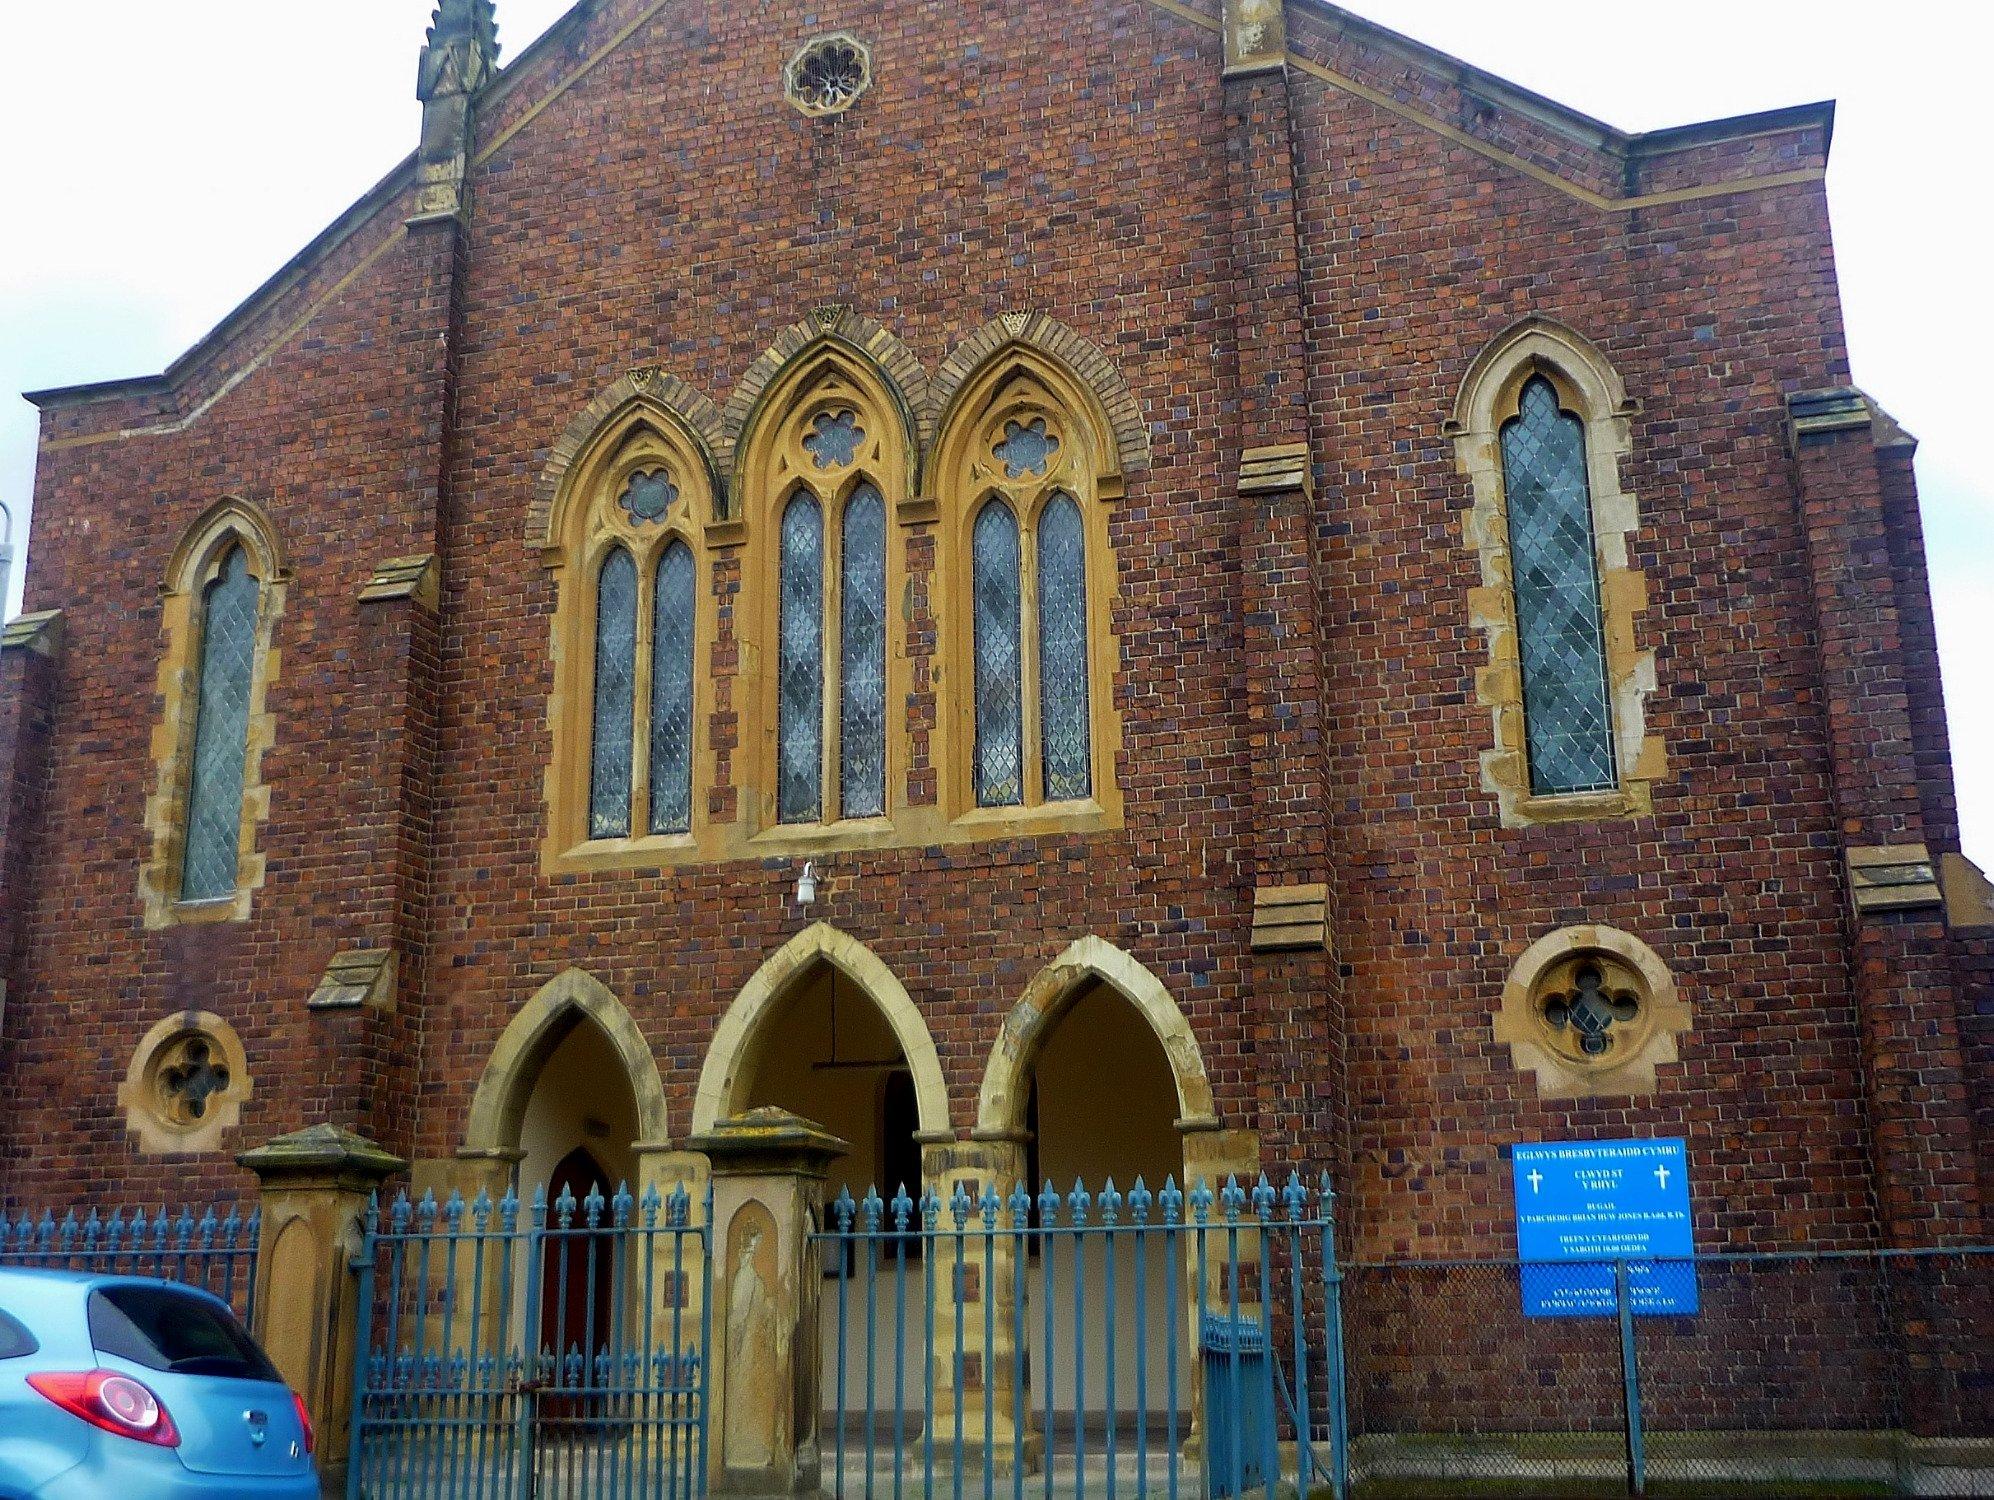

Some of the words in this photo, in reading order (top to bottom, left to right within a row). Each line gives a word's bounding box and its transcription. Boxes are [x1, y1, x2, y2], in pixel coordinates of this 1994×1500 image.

[1516, 1150, 1557, 1161] EGLWYS
[1559, 1146, 1641, 1159] BRESBYTERAIDD
[1642, 1145, 1678, 1157] CYMRU
[1574, 1169, 1610, 1179] CLWYD
[1611, 1168, 1624, 1178] ST
[1590, 1179, 1618, 1190] RHYL
[1572, 1212, 1596, 1221] BRIAN
[1618, 1210, 1642, 1220] JONES
